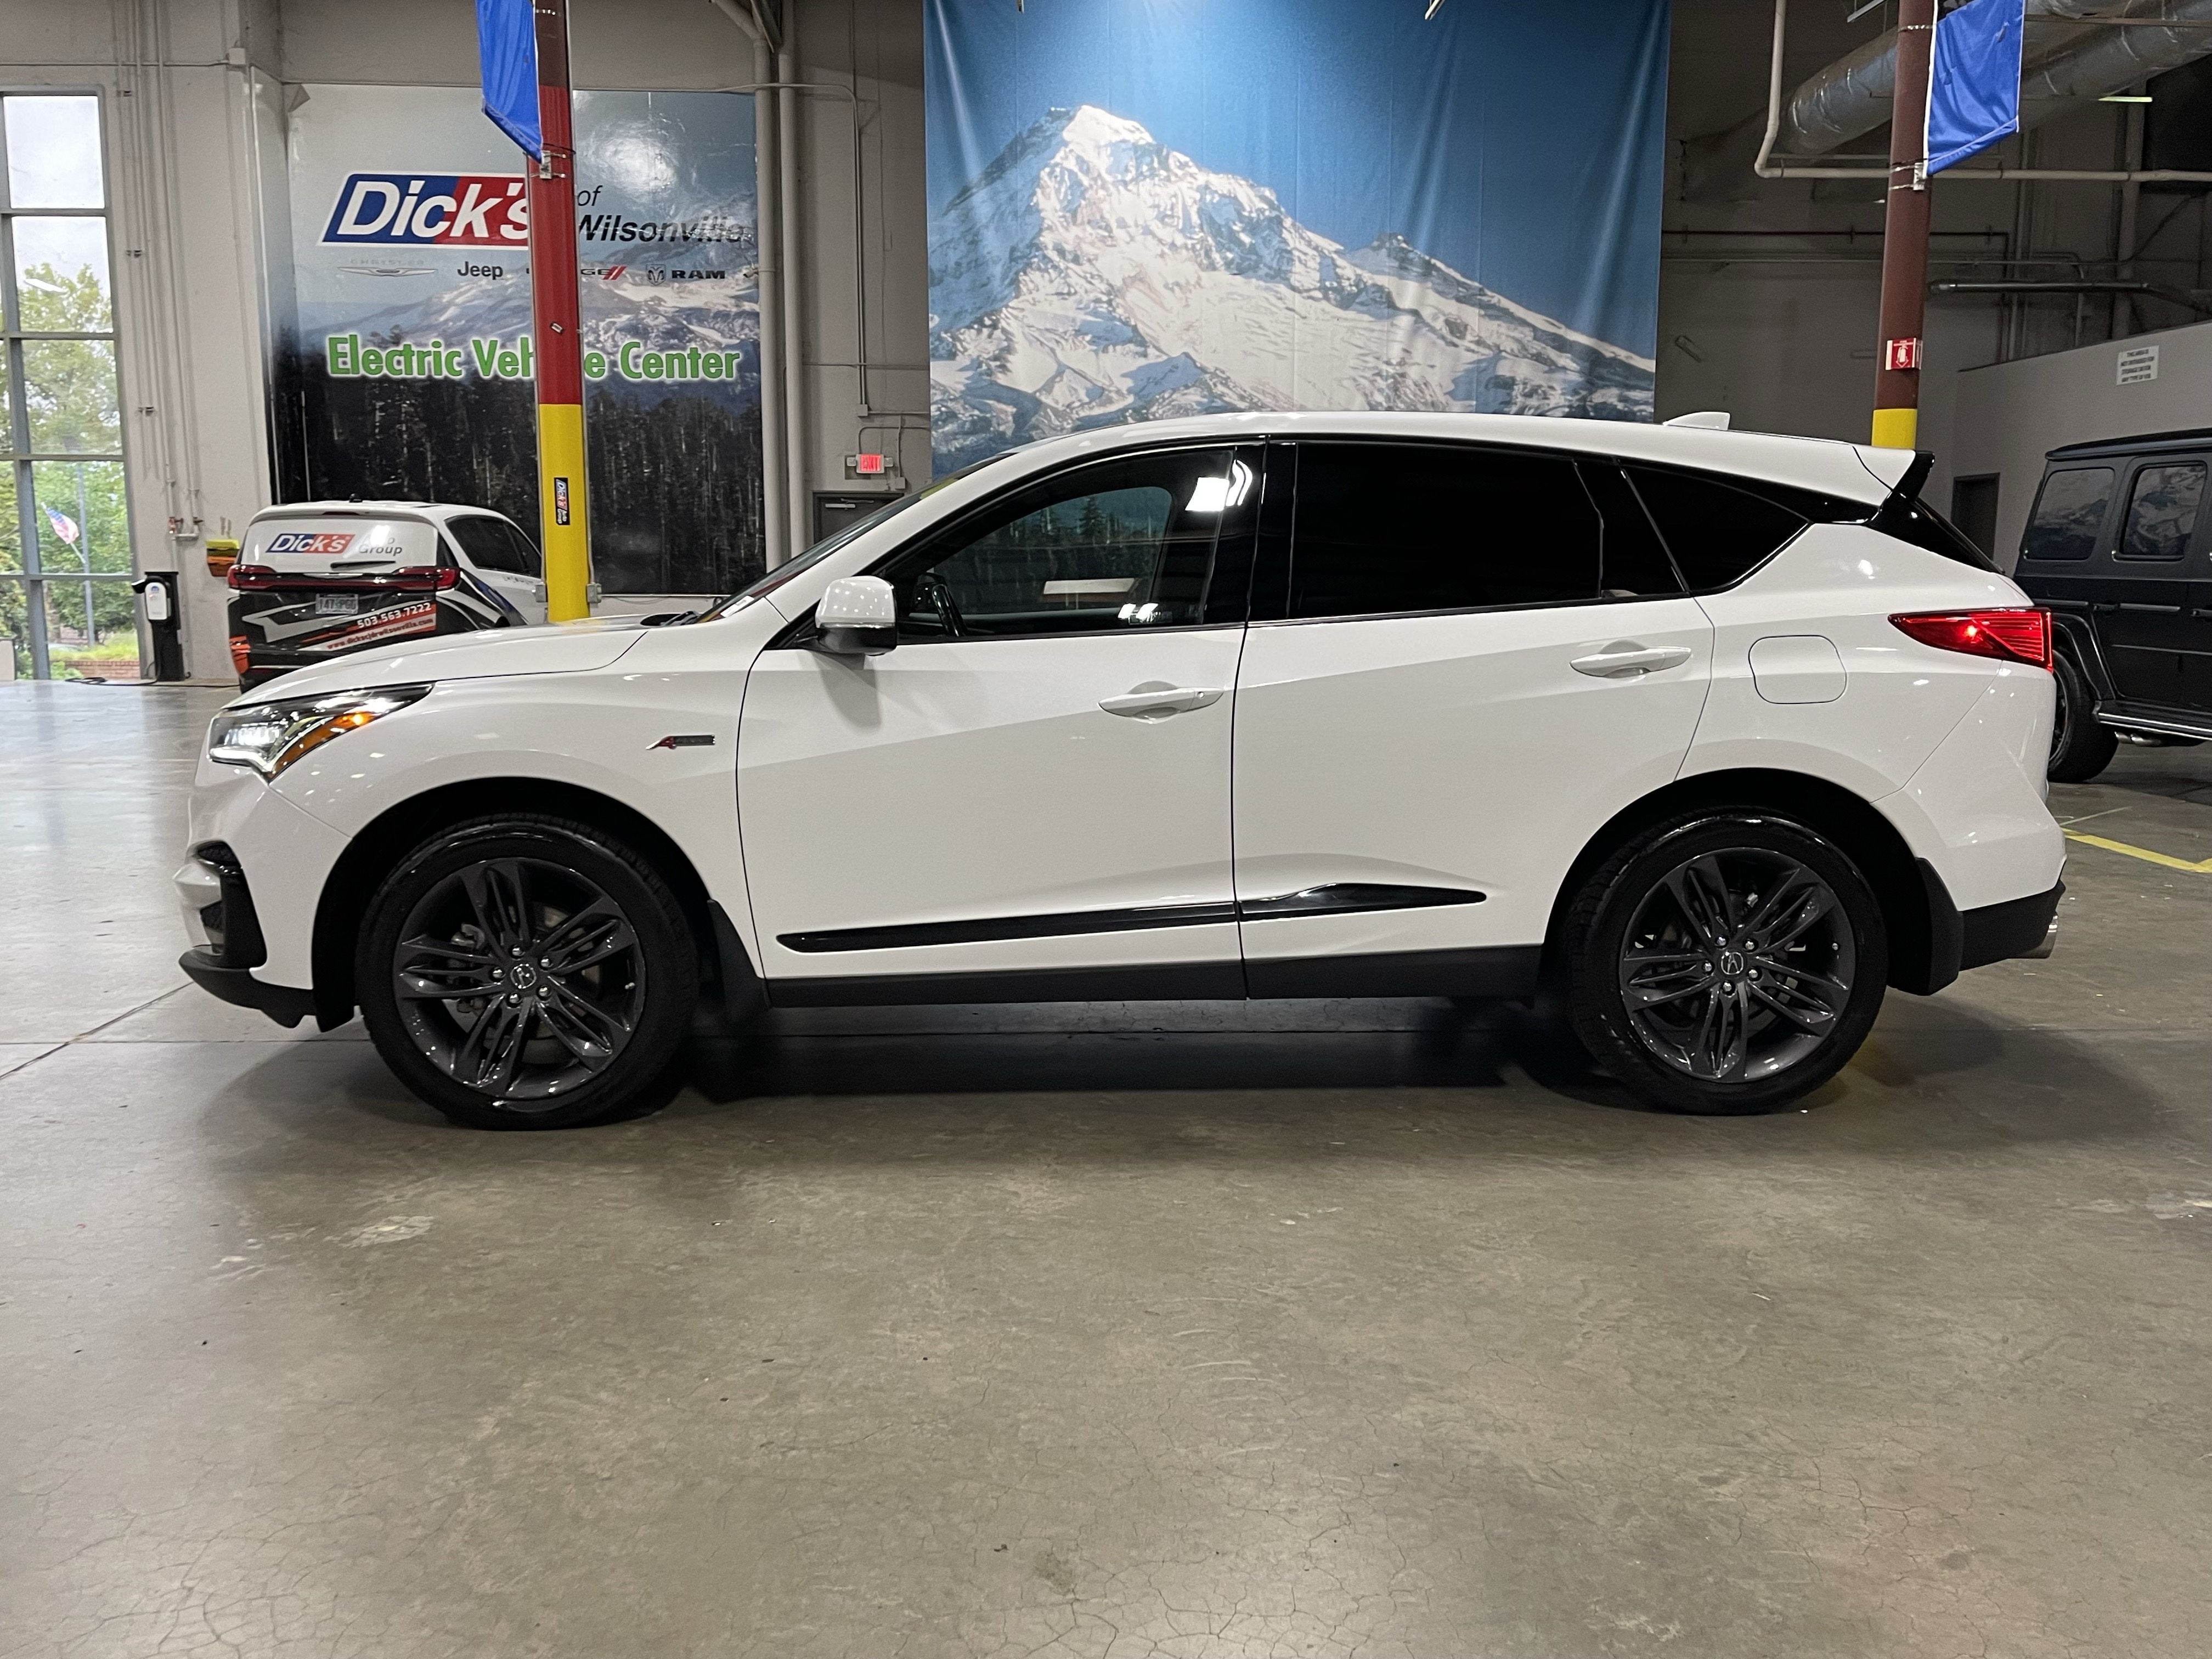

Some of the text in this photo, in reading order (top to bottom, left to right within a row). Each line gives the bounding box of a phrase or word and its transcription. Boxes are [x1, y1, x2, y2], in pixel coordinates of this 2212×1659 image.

[578, 185, 602, 206] of
[336, 180, 528, 240] Dick's
[457, 261, 504, 280] Jeep
[672, 269, 726, 279] RAM
[328, 334, 741, 379] Electric Vehe Center
[861, 455, 881, 471] EXIT
[270, 534, 346, 552] Dick's
[359, 544, 403, 557] Group
[357, 602, 432, 629] 503.563.7222
